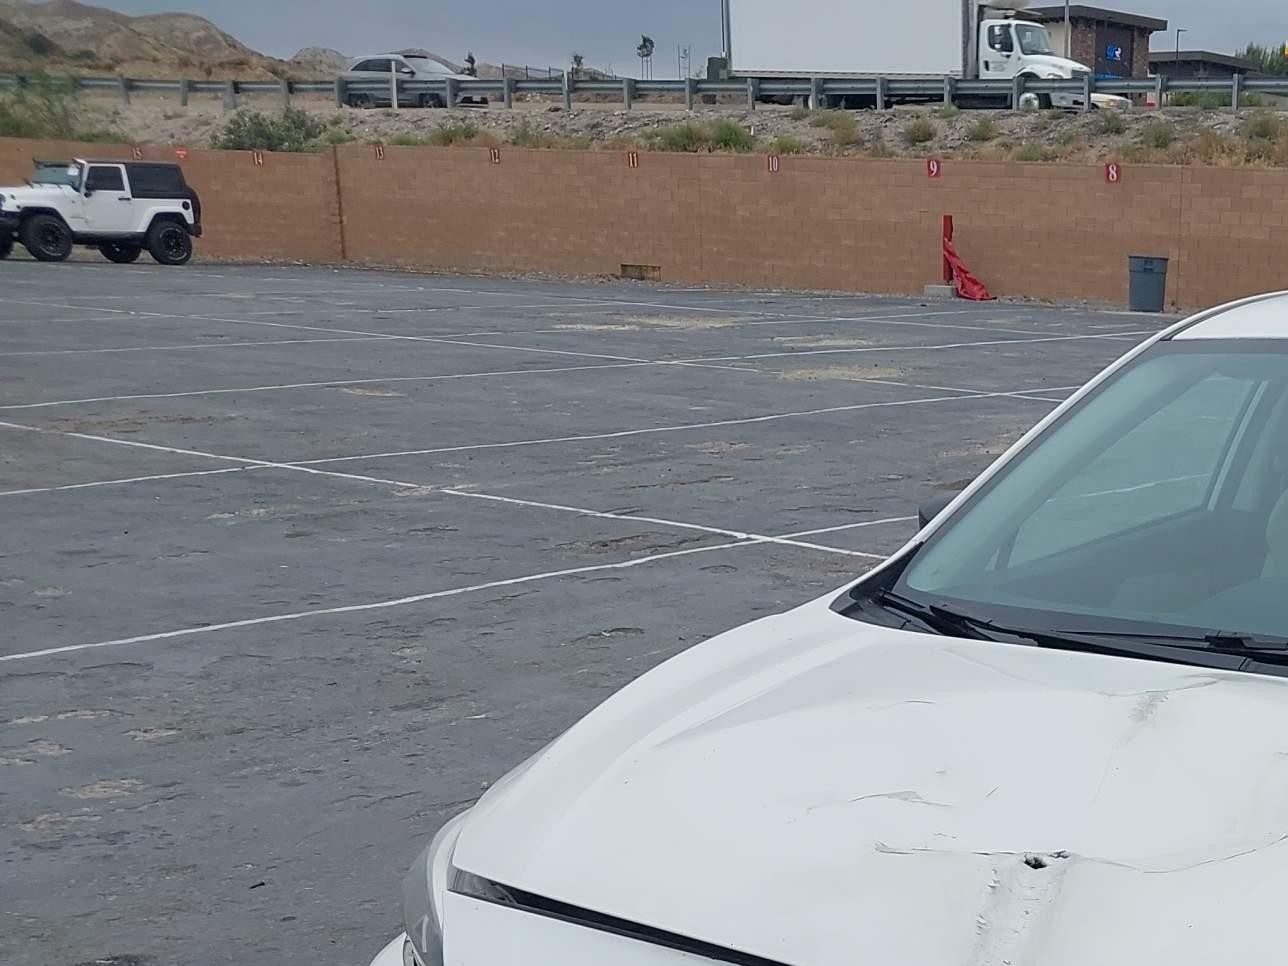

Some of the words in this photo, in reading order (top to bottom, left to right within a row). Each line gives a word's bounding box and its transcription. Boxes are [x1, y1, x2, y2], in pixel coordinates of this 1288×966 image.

[629, 152, 638, 168] 11
[768, 156, 778, 171] 10
[929, 160, 938, 177] 9
[1108, 164, 1117, 182] 8
